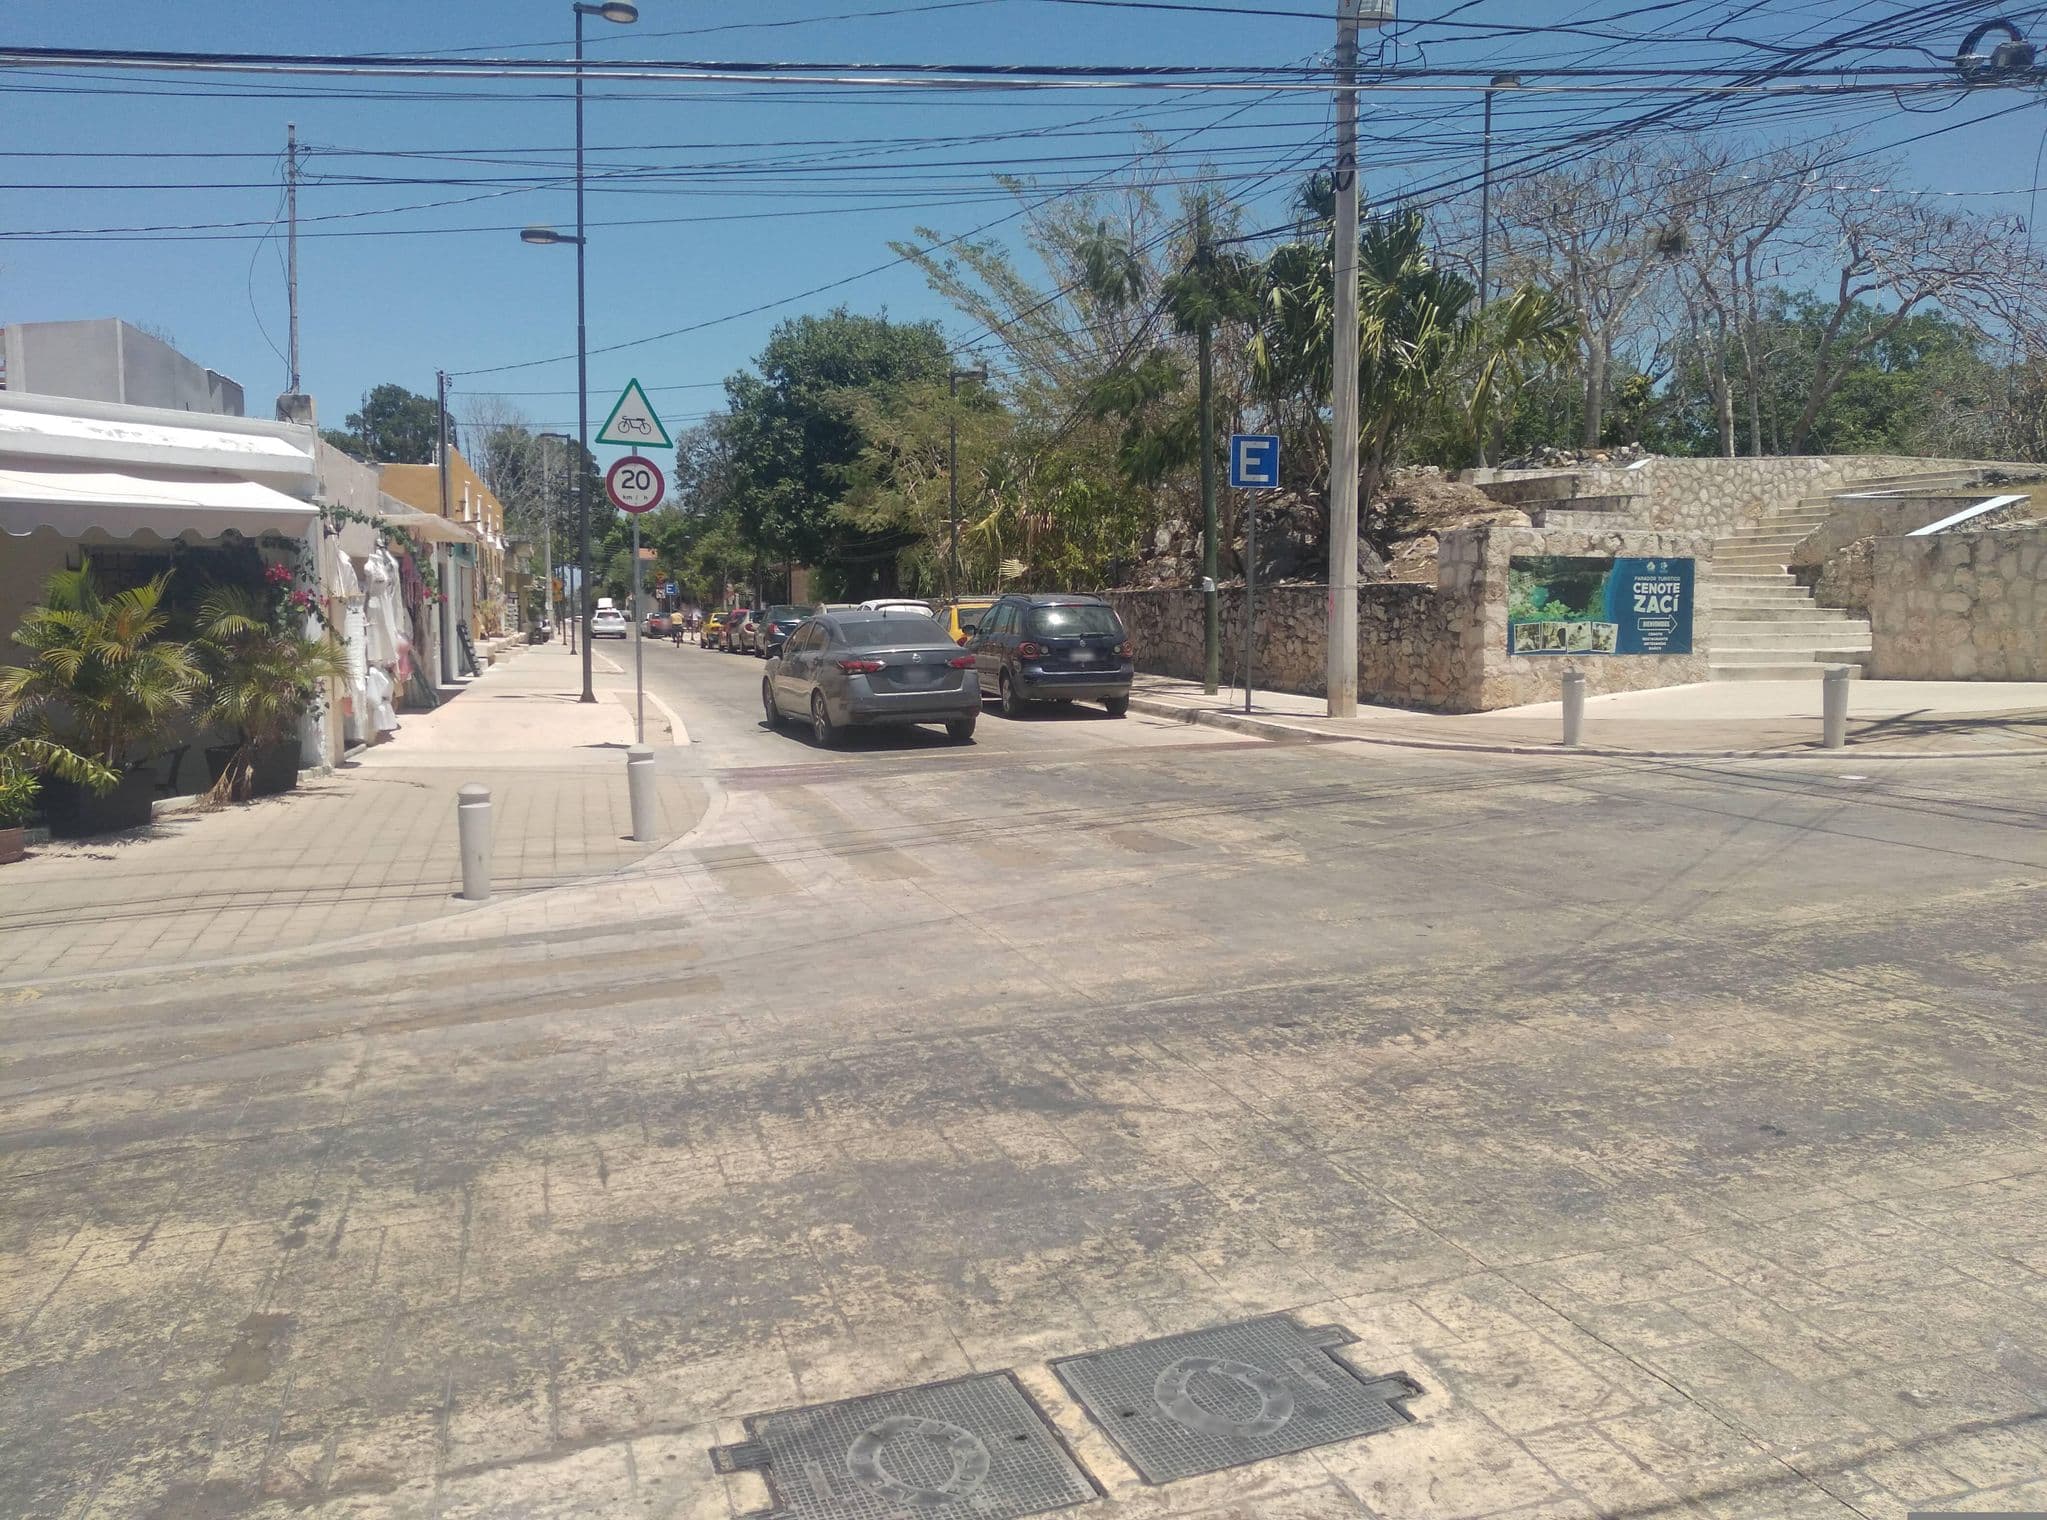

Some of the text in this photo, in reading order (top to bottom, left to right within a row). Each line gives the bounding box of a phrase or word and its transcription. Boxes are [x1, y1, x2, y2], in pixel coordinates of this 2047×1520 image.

[1240, 441, 1270, 482] E
[621, 469, 650, 490] 20
[1633, 583, 1680, 594] CENOTE
[1633, 594, 1680, 613] ZACÍ
